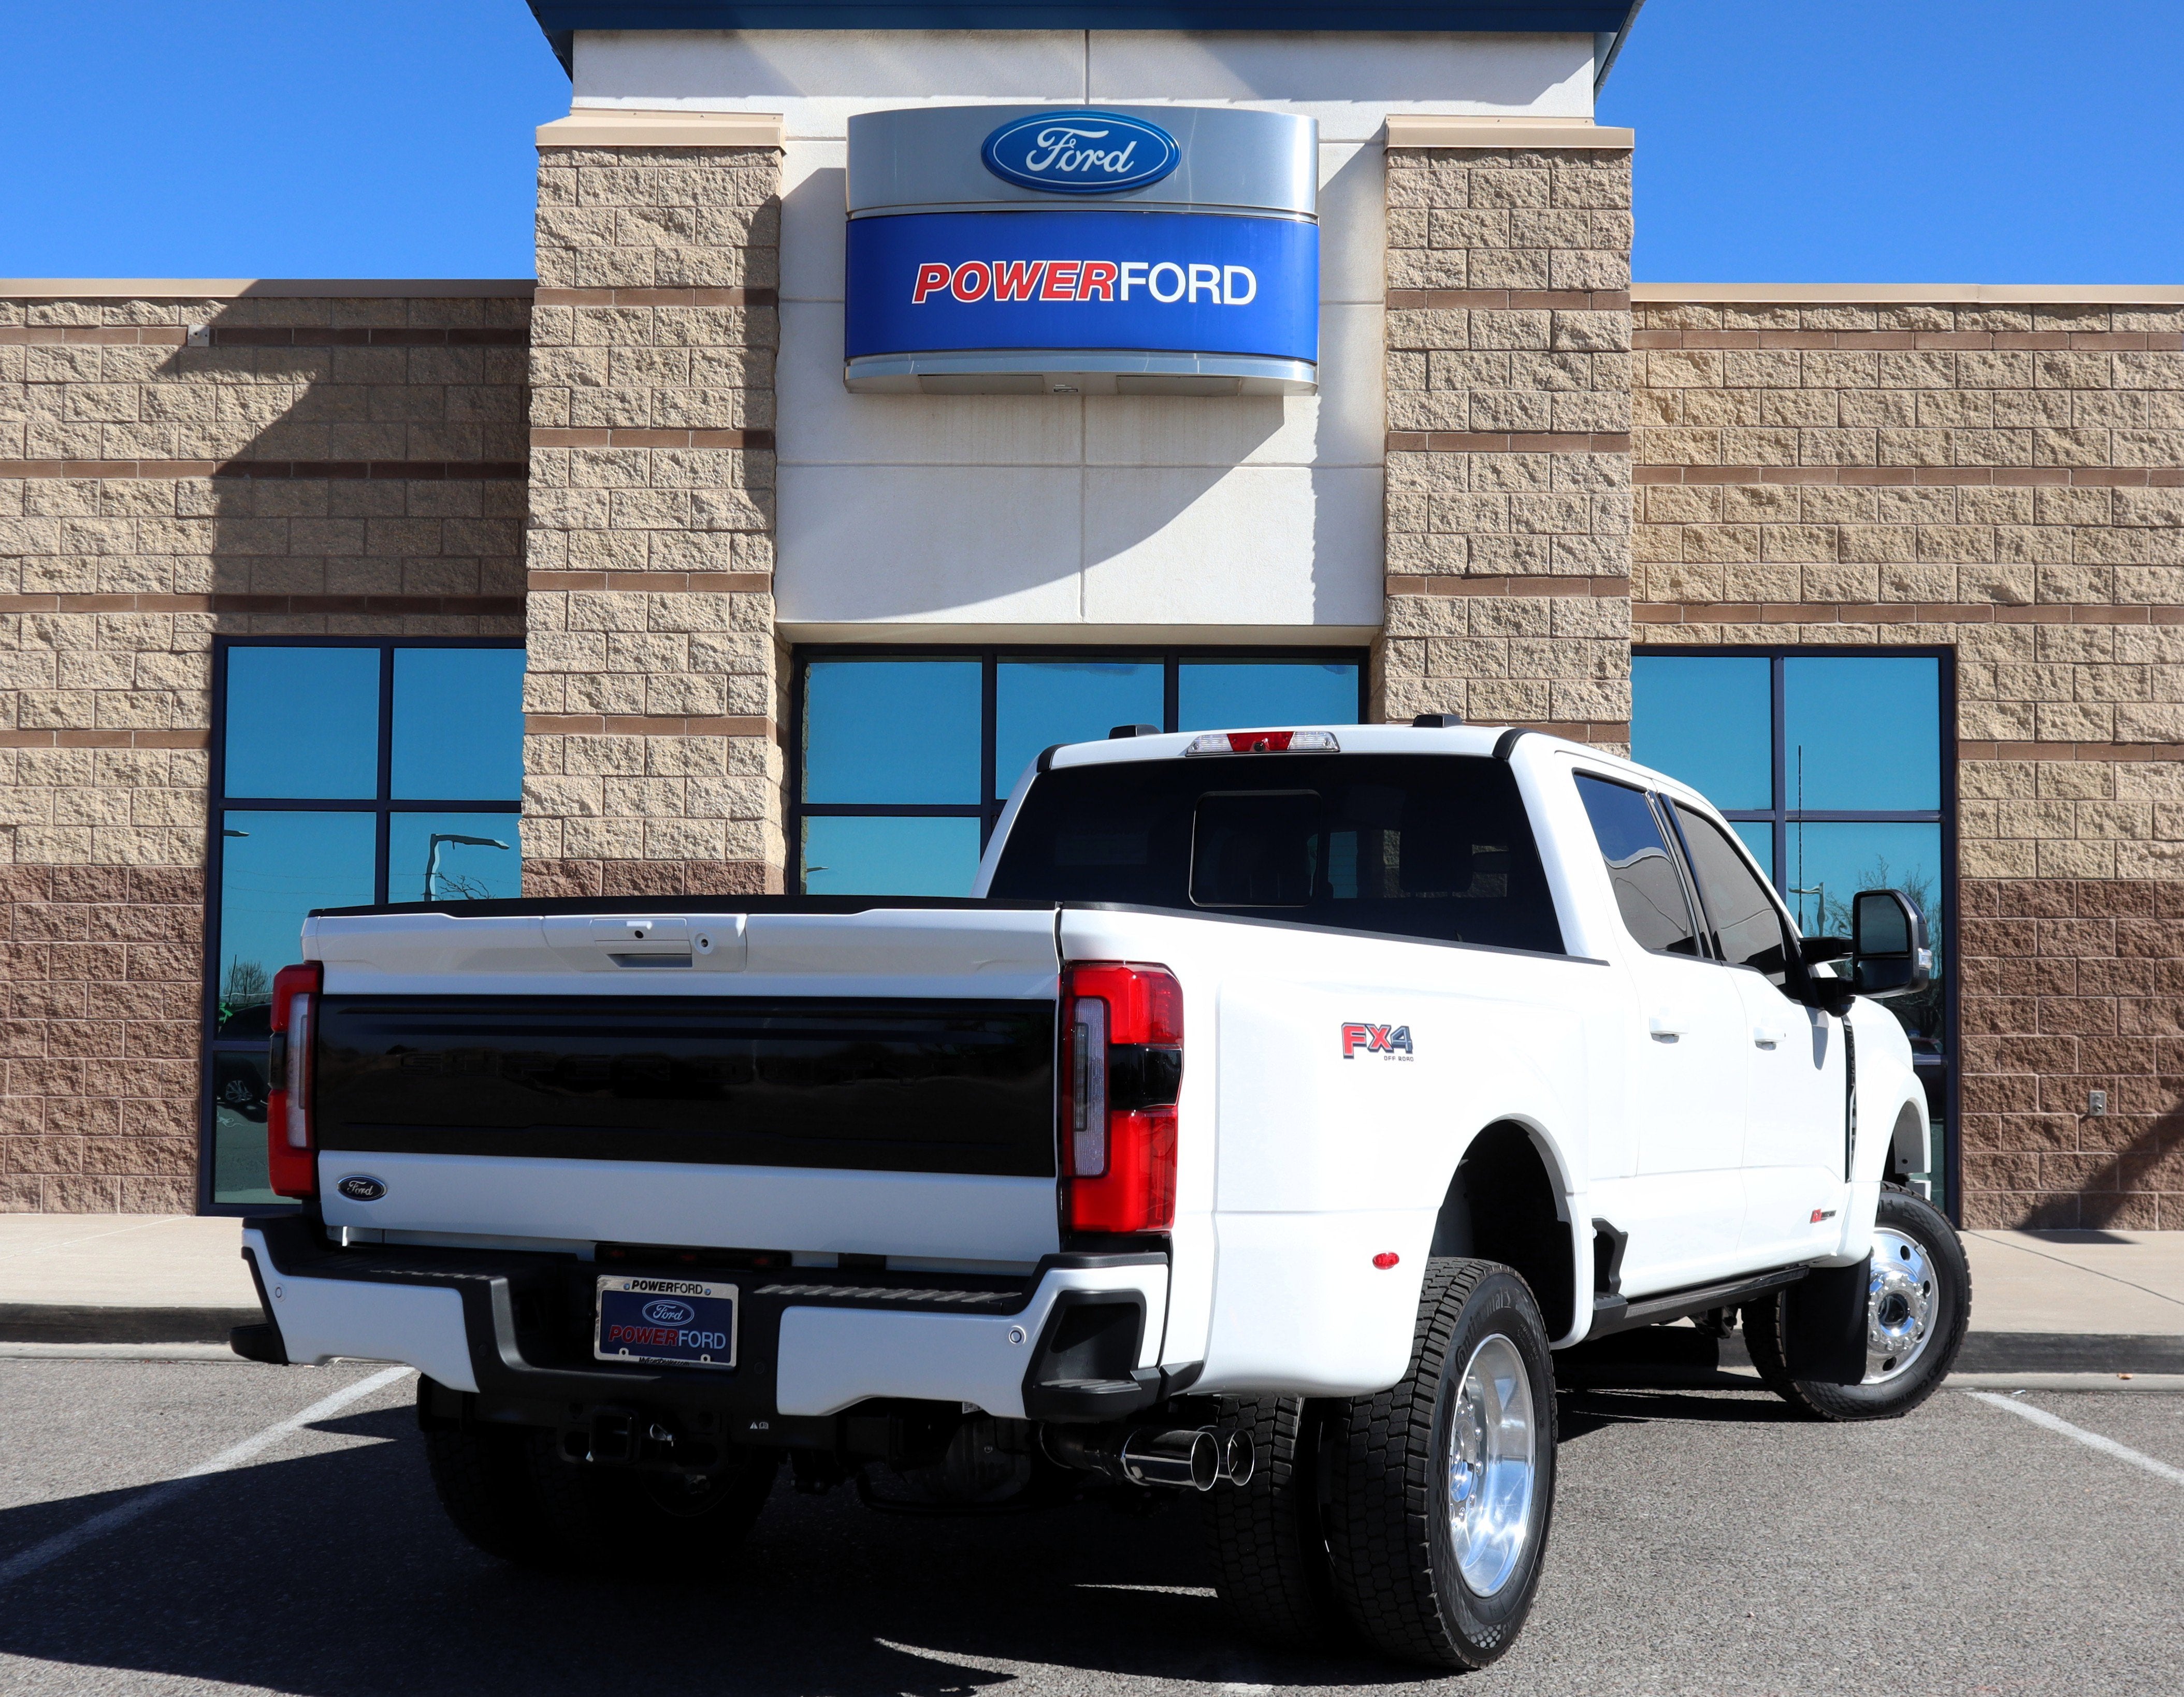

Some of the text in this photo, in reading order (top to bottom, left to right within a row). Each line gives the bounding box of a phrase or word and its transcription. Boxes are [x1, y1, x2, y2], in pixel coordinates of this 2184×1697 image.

[1025, 126, 1134, 173] Ford
[911, 260, 1257, 306] POWERFORD
[1341, 1022, 1413, 1060] FX4
[346, 1180, 374, 1196] Ford
[631, 1280, 703, 1295] POWERFORD
[652, 1304, 684, 1321] Ford
[608, 1325, 726, 1350] POWERFORD
[1455, 1286, 1504, 1375] Continntal
